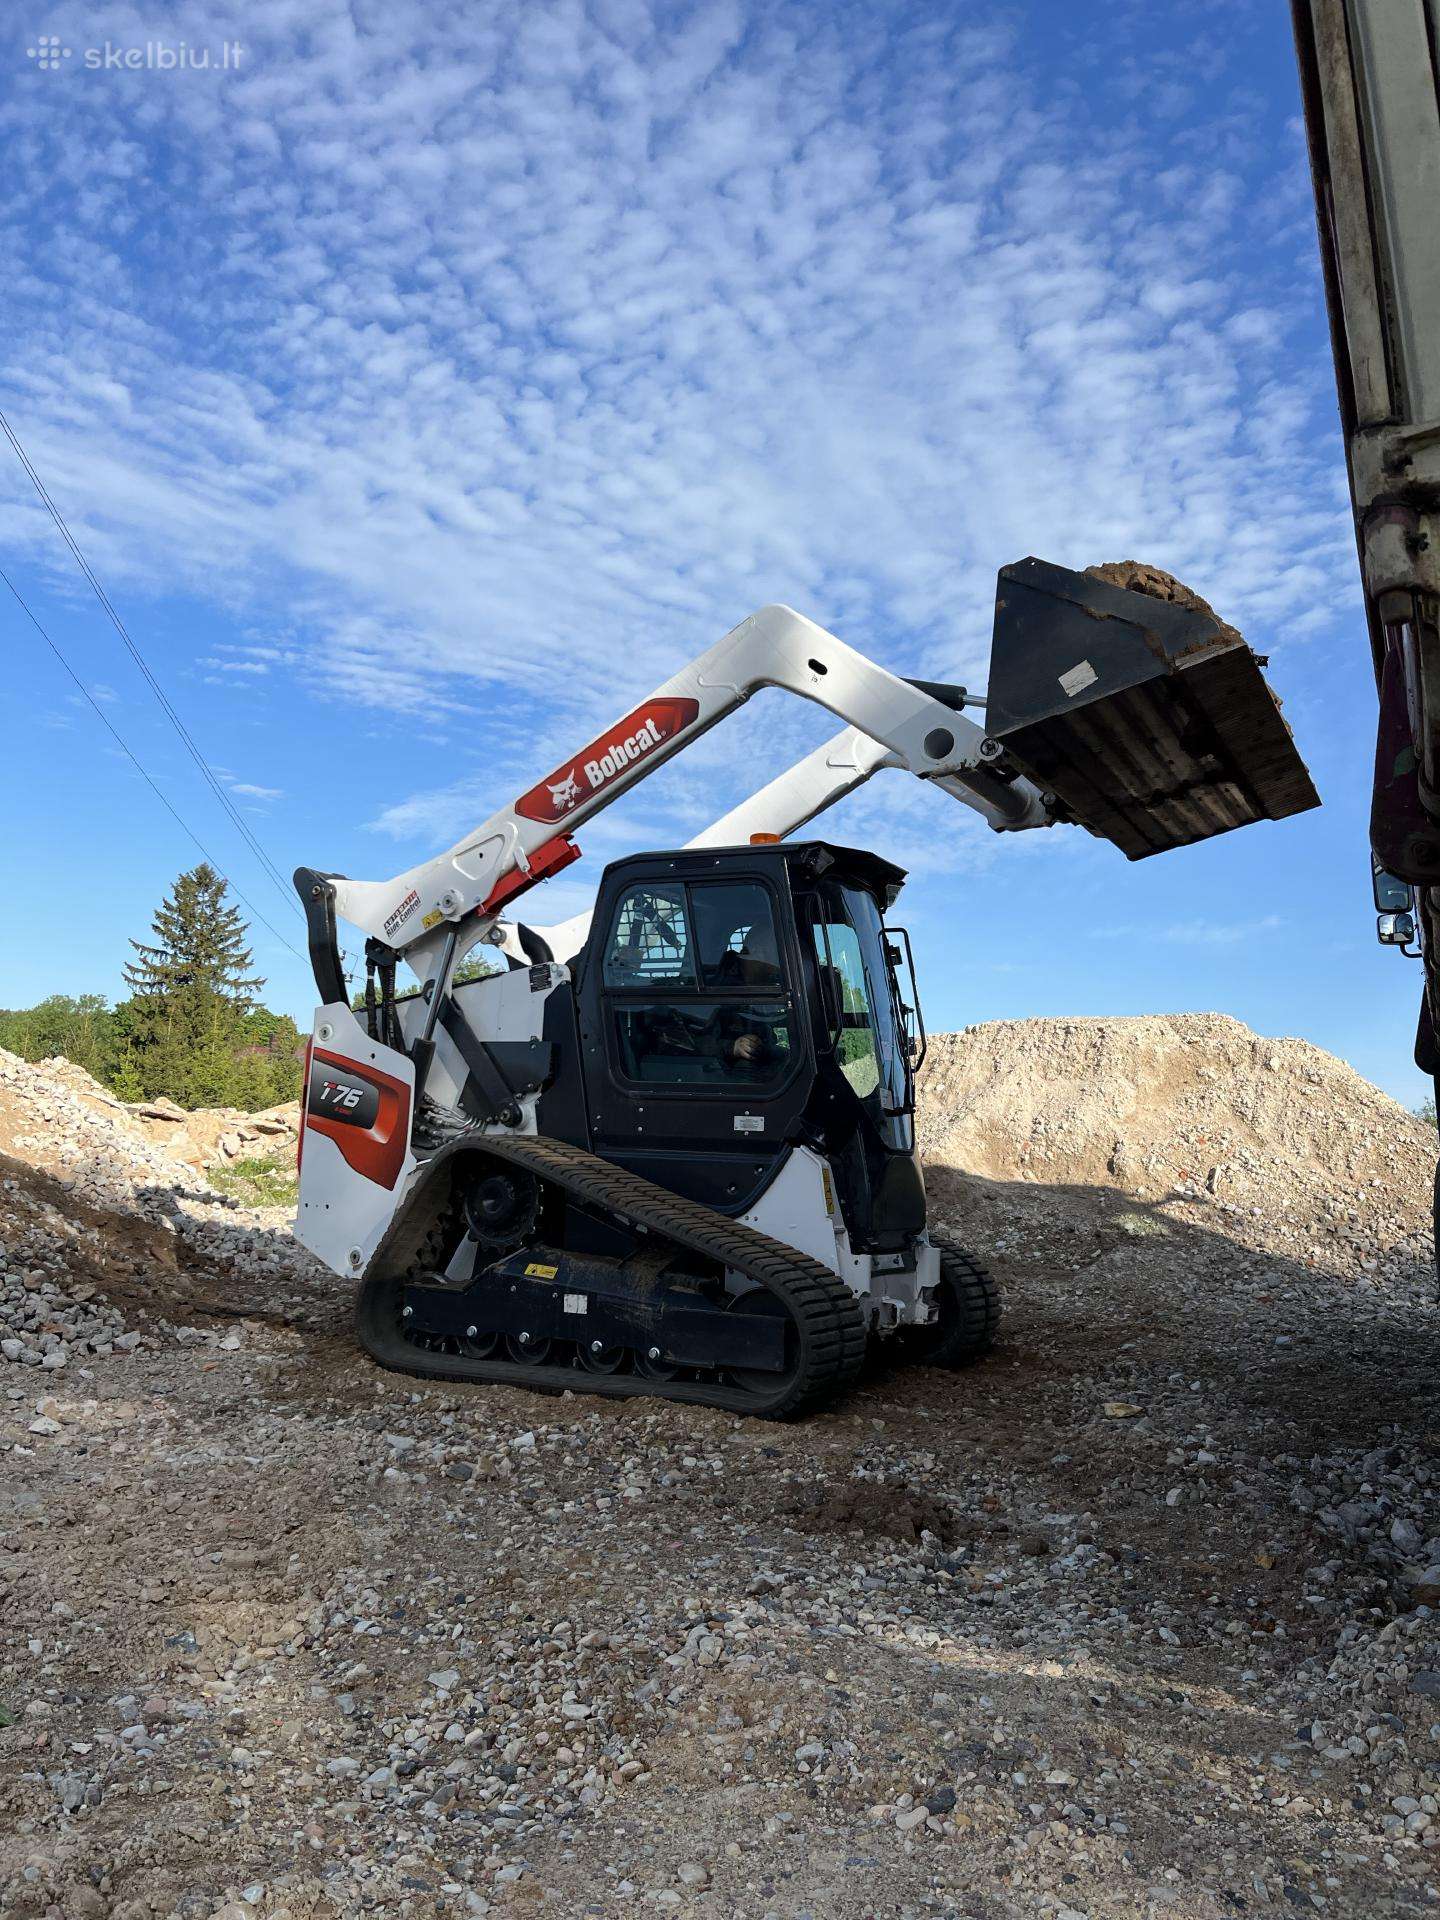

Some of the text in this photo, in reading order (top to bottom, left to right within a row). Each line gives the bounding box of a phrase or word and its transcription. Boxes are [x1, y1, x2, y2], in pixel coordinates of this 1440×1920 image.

[584, 718, 663, 788] Bobcat
[399, 896, 421, 923] Control
[320, 1081, 364, 1108] T76
